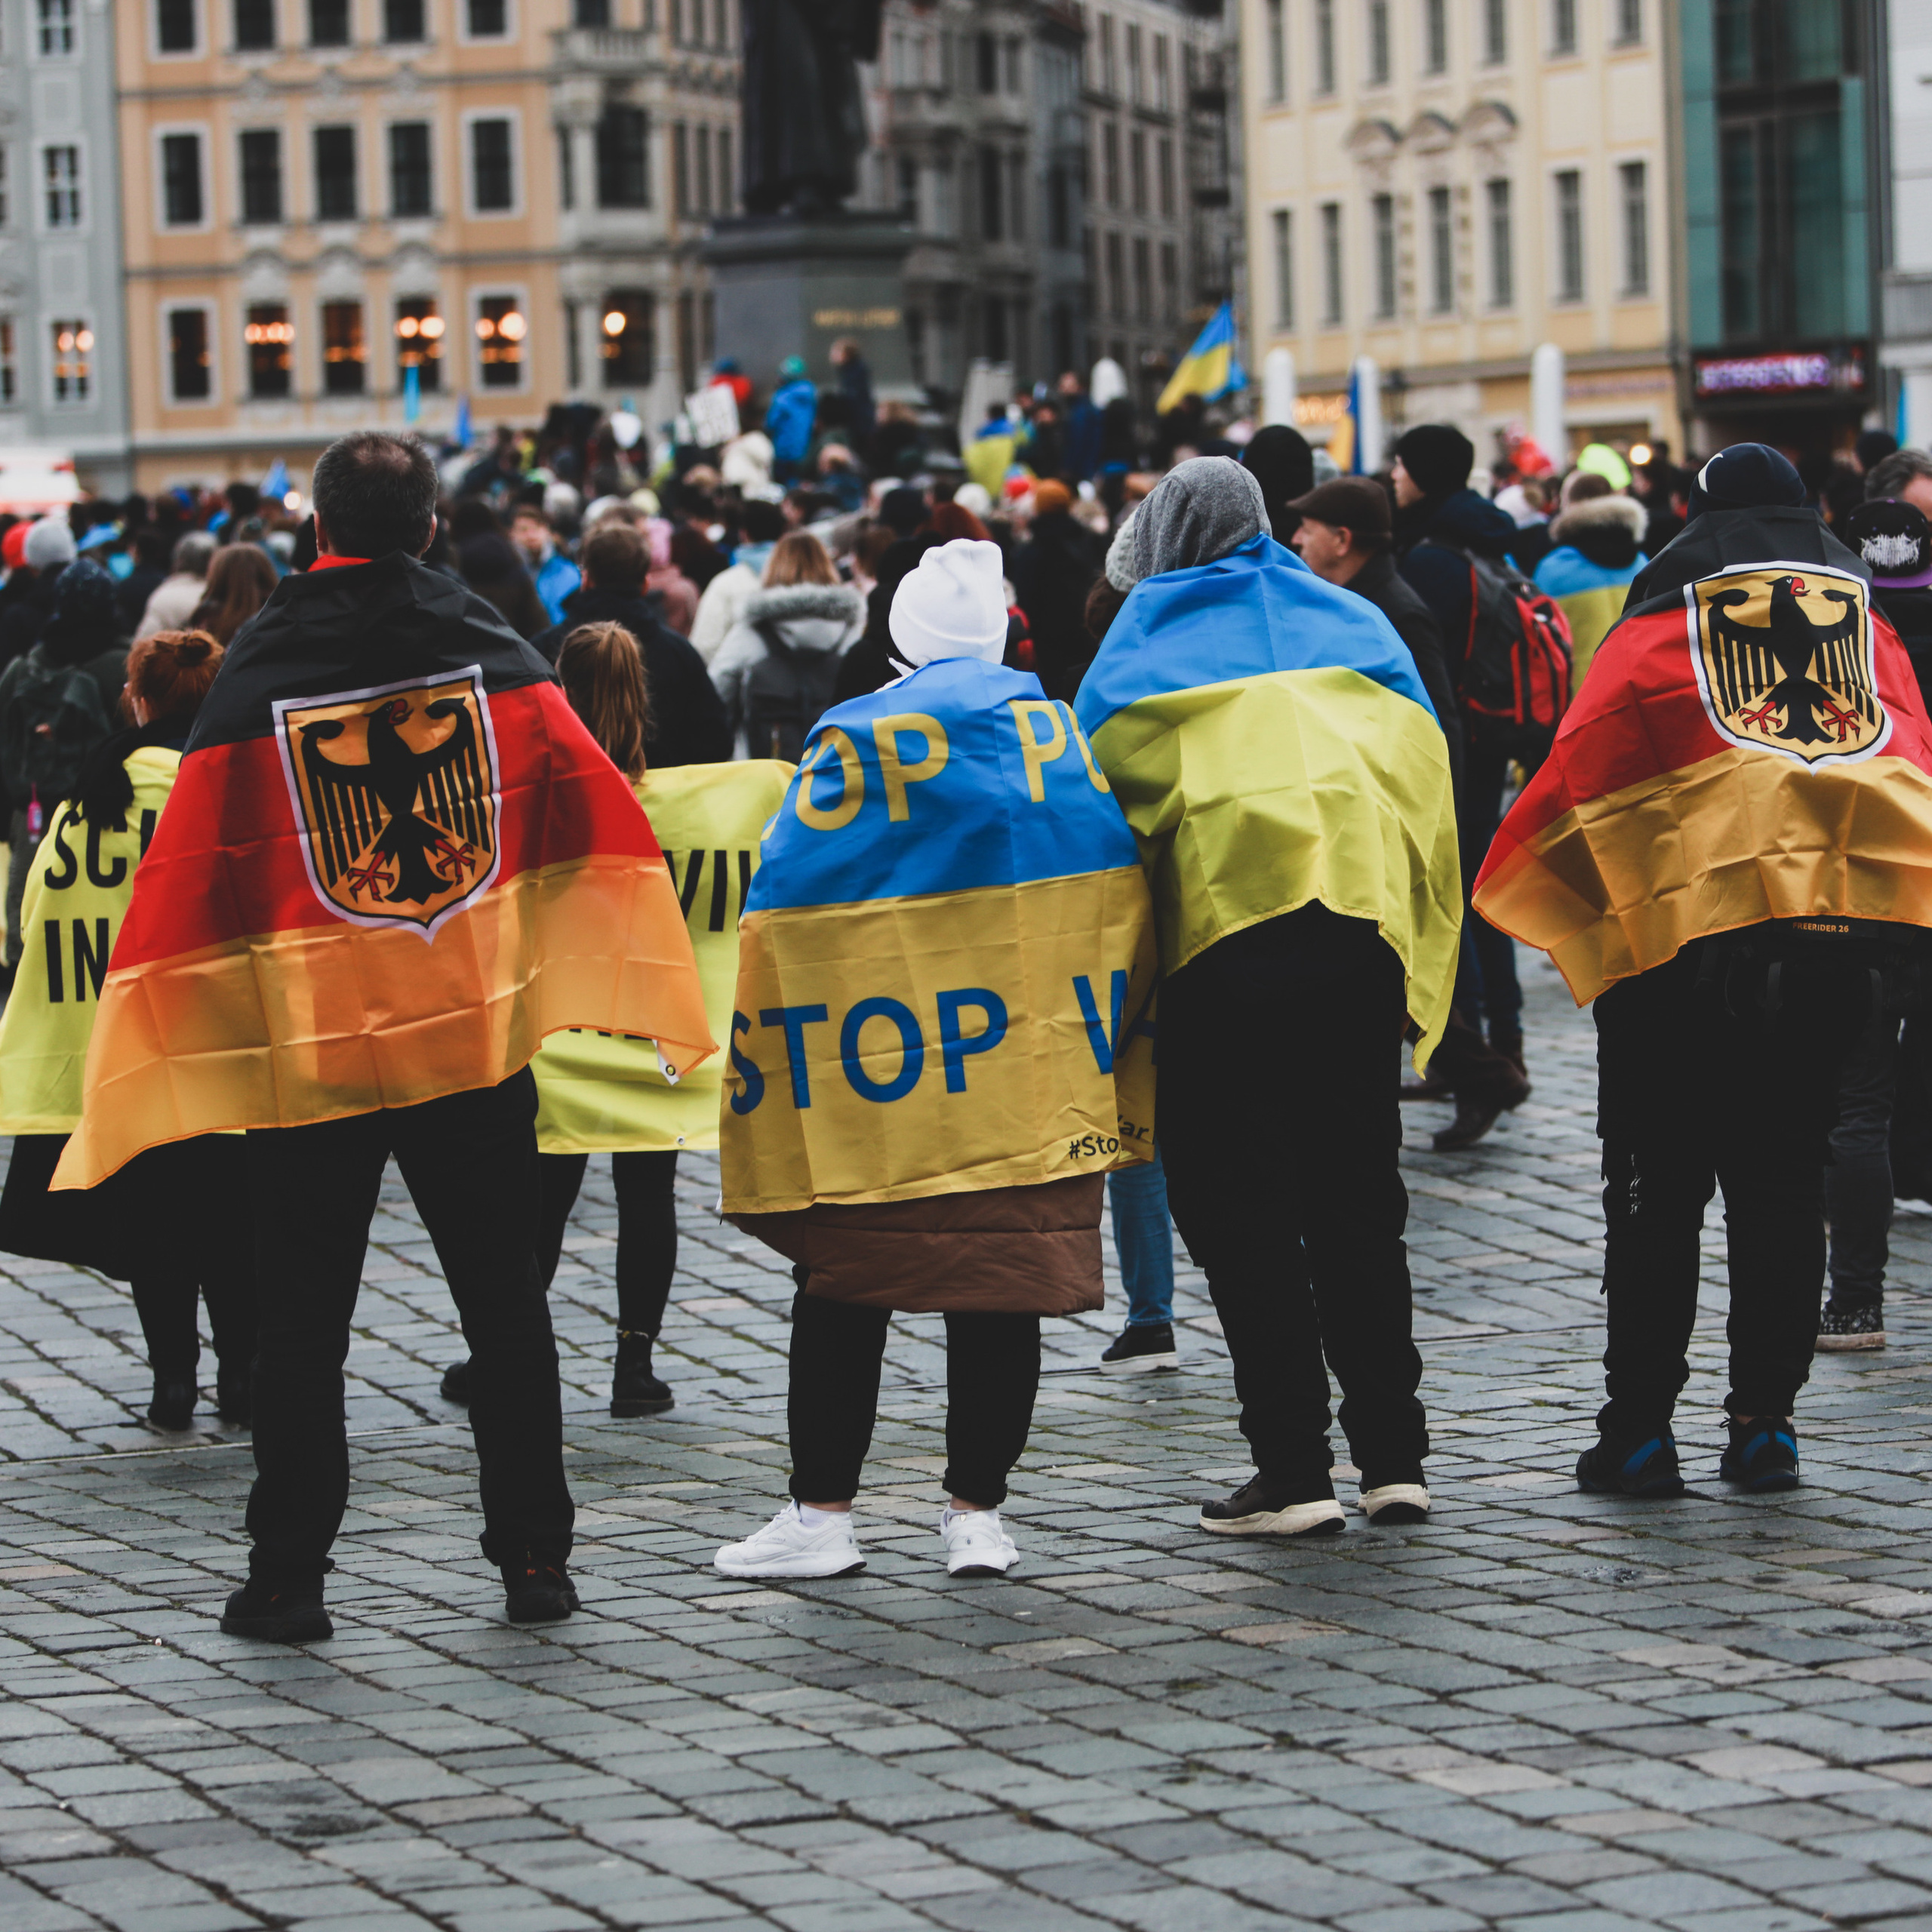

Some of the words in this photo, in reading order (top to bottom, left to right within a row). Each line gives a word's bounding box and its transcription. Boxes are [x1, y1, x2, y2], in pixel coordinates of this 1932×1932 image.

[1792, 921, 1837, 933] FREERIDER
[1838, 924, 1849, 933] 26
[729, 986, 1009, 1116] STOP
